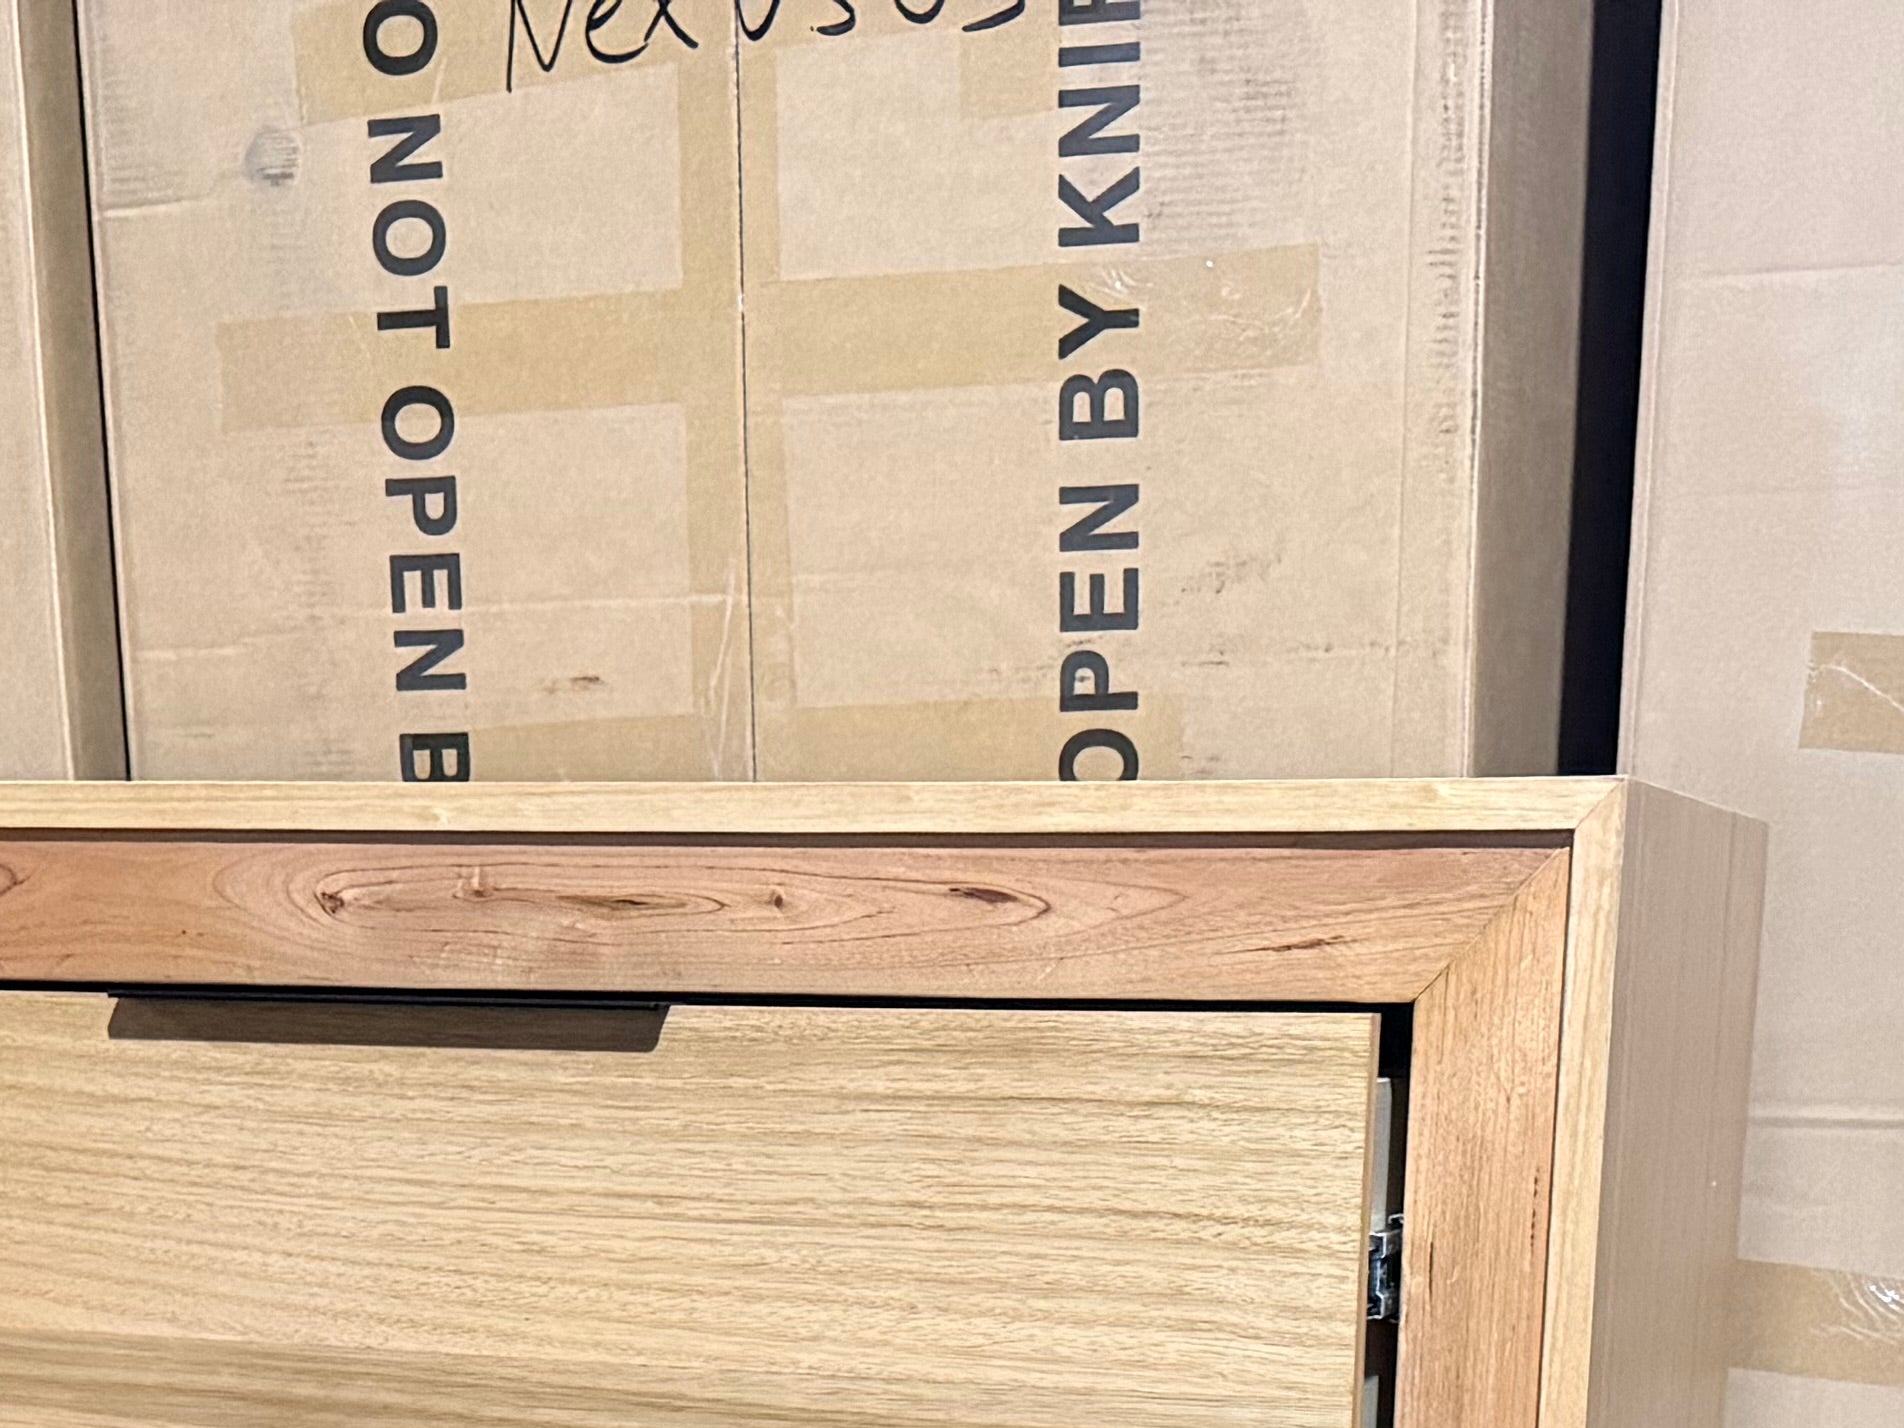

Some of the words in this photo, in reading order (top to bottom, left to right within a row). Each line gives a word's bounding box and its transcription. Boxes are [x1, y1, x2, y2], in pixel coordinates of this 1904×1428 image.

[363, 0, 439, 76] O
[1058, 0, 1141, 248] KNI
[367, 113, 452, 350] NOT
[1058, 283, 1140, 441] BY
[381, 384, 467, 691] OPEN
[1058, 483, 1140, 781] OPEN
[399, 732, 471, 782] B
